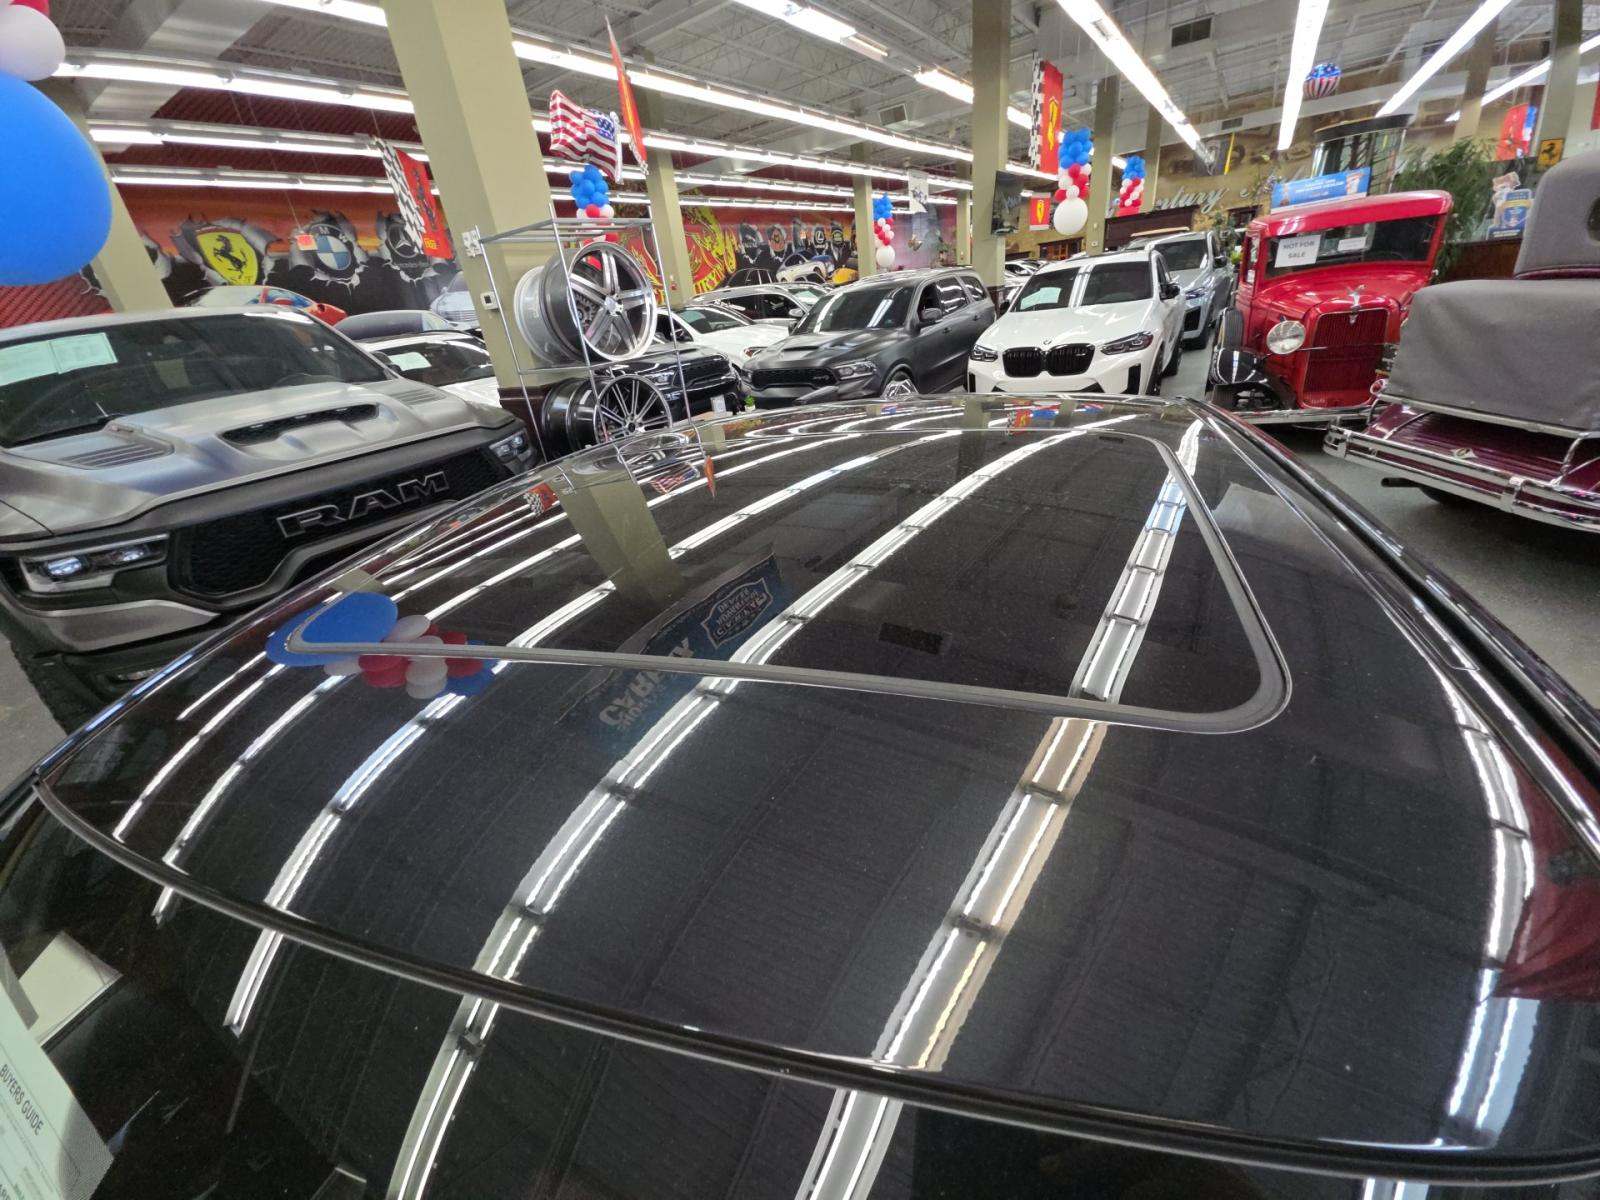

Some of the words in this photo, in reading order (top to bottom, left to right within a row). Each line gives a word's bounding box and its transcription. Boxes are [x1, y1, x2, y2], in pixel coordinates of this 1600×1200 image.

[1282, 242, 1299, 250] NOT
[1287, 251, 1306, 259] SALE
[276, 471, 450, 539] RAM
[0, 1064, 25, 1105] BUYERS
[21, 1100, 44, 1136] GUIDE
